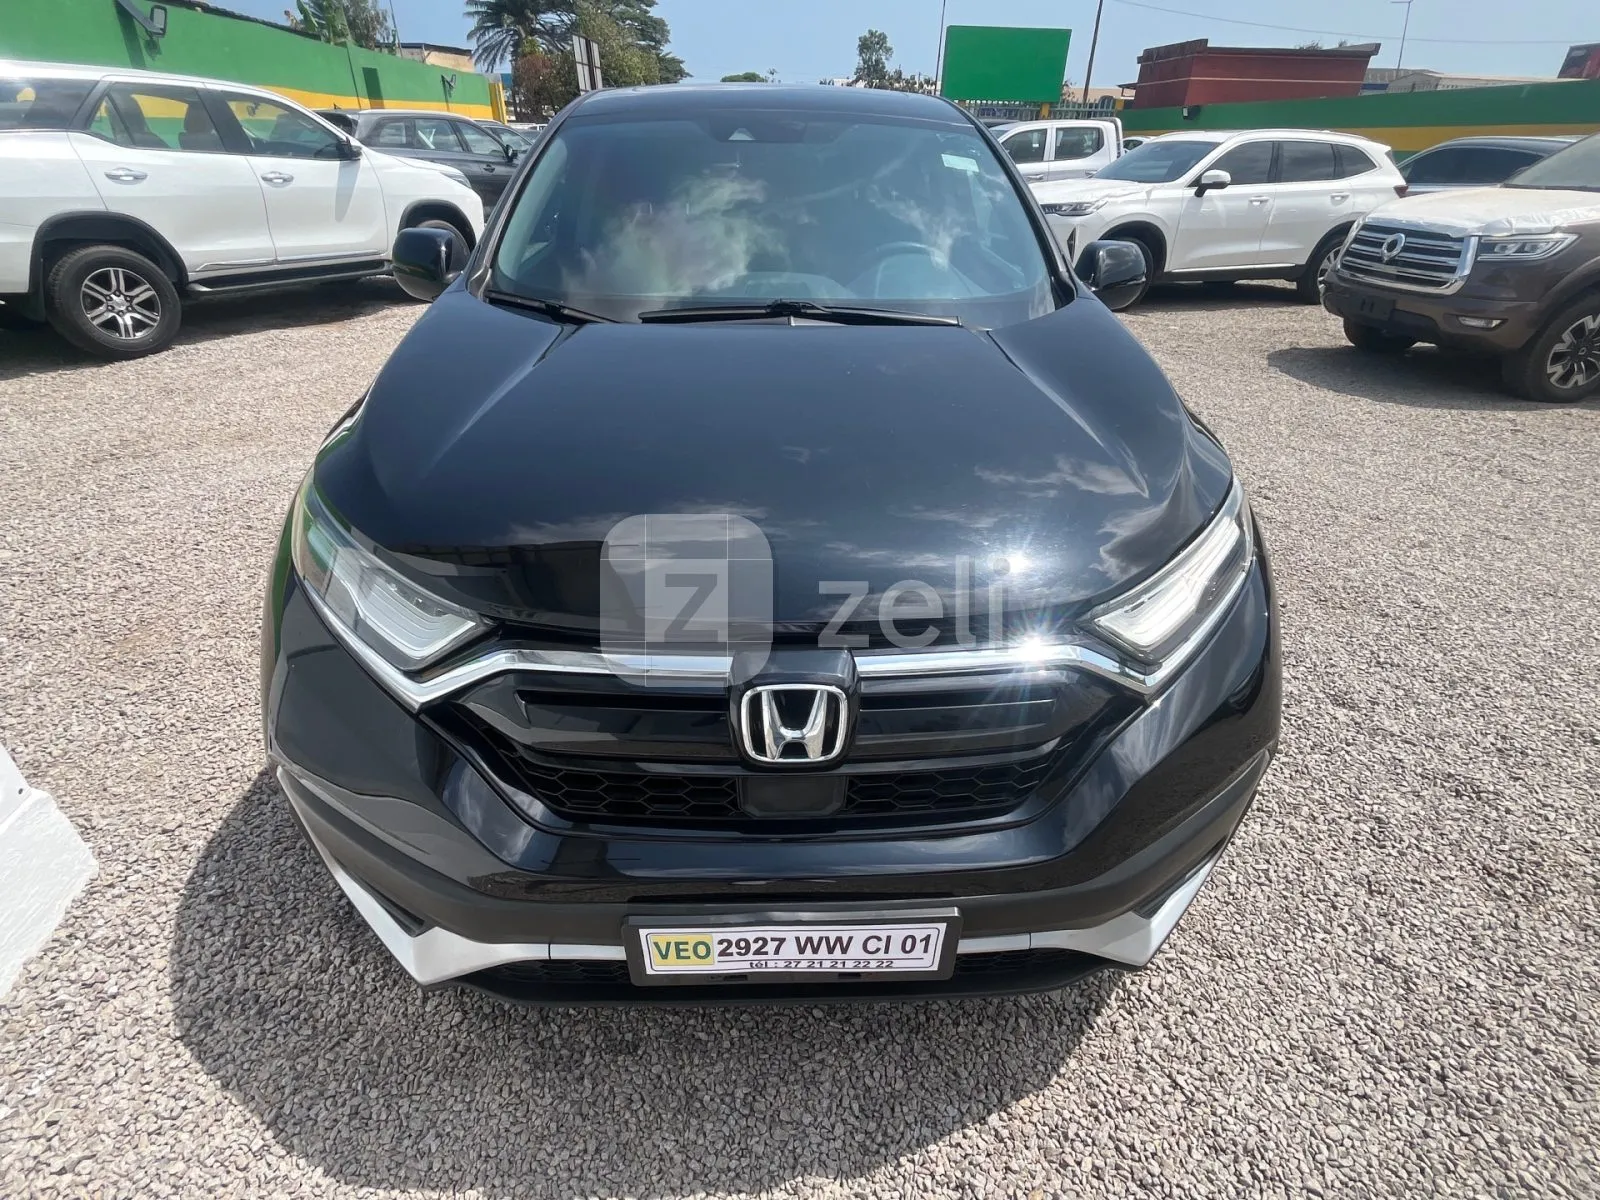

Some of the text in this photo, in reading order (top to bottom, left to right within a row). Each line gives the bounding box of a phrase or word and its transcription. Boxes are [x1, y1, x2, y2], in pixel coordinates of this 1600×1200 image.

[653, 934, 932, 960] VEO 2927 WW CI 01
